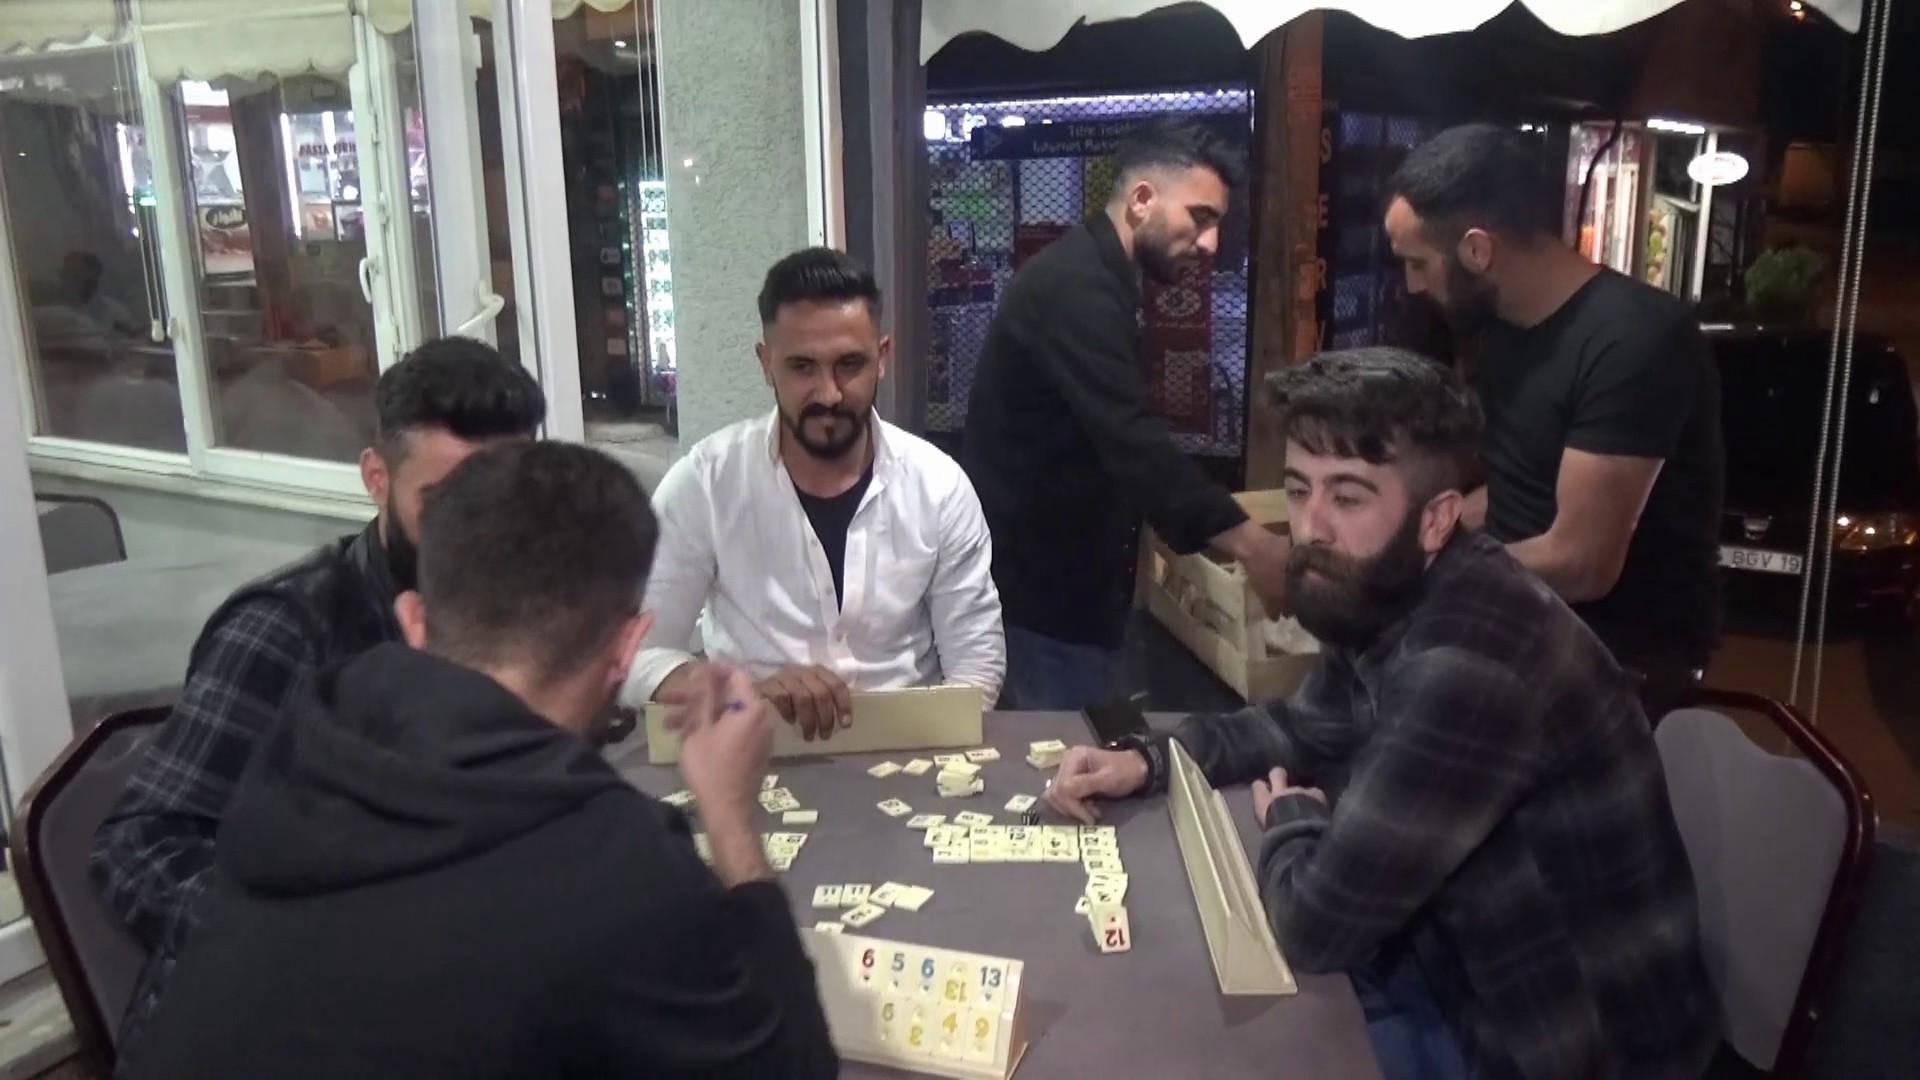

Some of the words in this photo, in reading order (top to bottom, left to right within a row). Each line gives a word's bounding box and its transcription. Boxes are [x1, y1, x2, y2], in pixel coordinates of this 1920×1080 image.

[1105, 928, 1126, 947] 12
[862, 949, 875, 968] 6
[891, 953, 905, 972] 5
[921, 958, 935, 978] 6
[980, 966, 1001, 988] 13
[942, 1012, 958, 1034] 4
